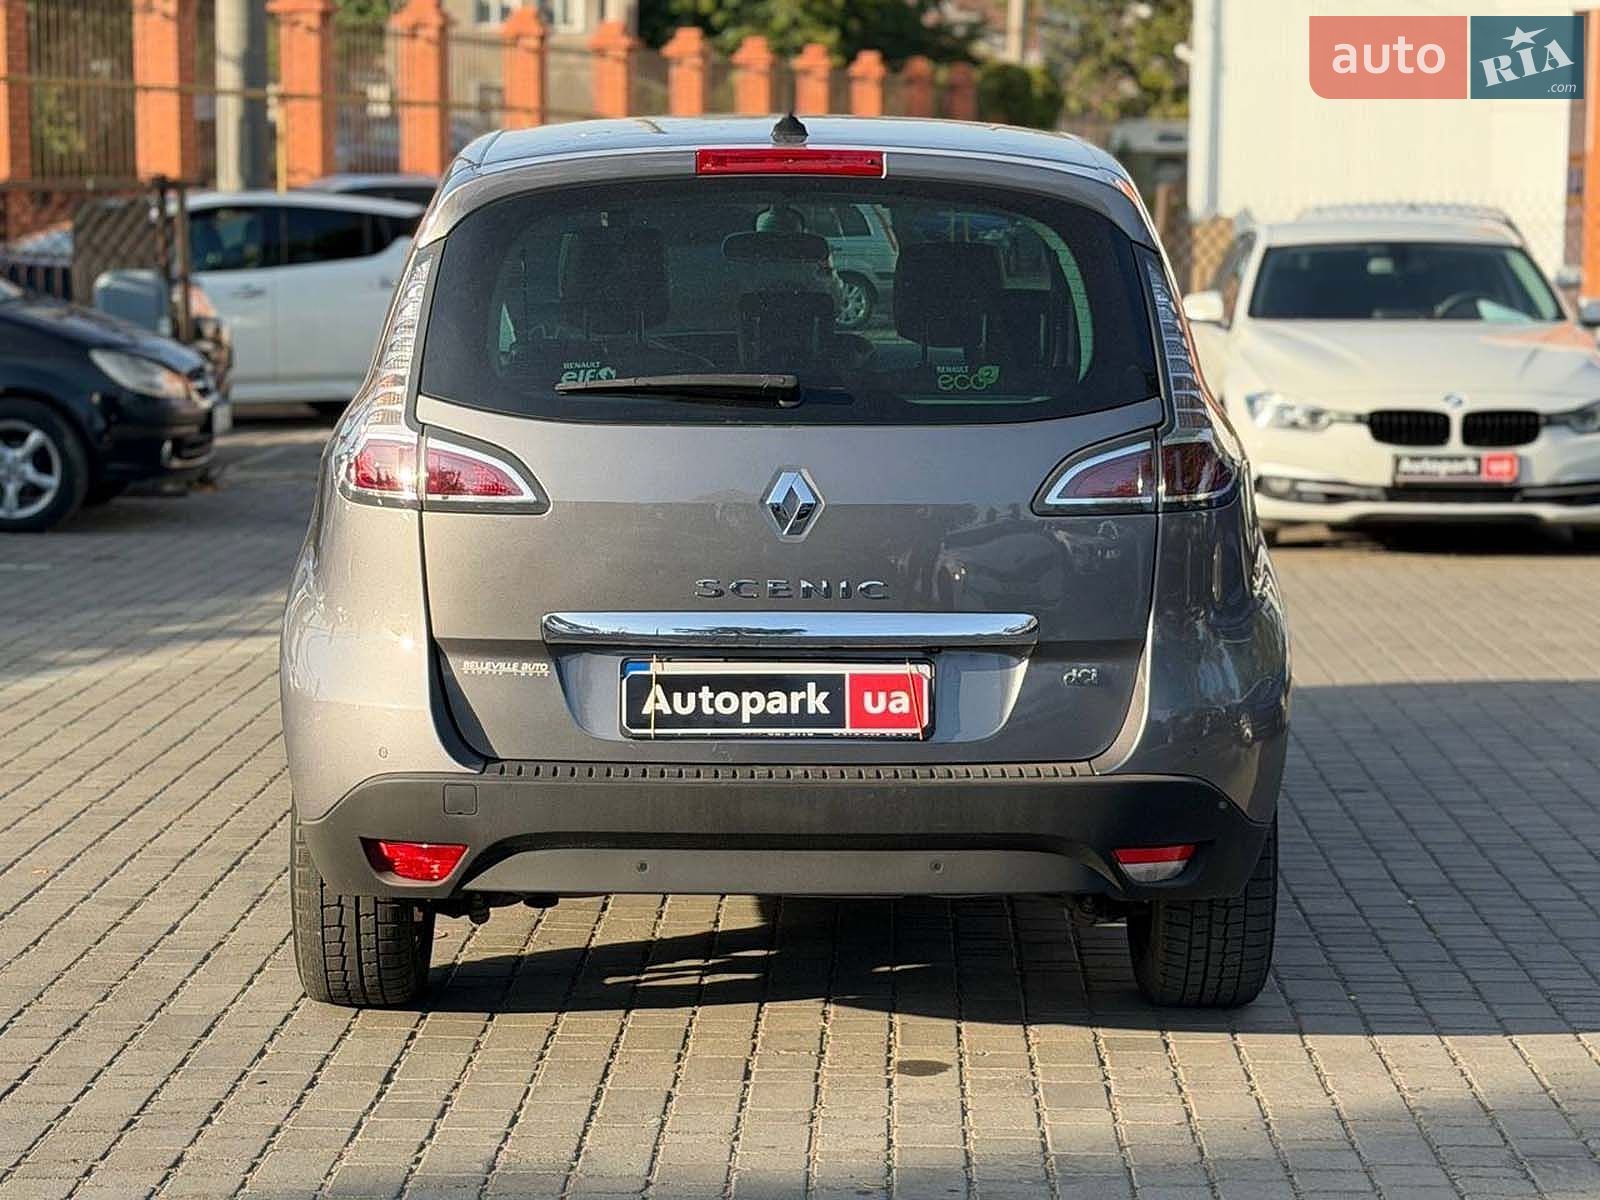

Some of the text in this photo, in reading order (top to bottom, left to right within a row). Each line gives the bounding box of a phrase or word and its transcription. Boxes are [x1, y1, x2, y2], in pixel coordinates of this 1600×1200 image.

[563, 361, 600, 369] RENAULT
[694, 578, 890, 599] SCENIC
[463, 660, 549, 672] BELLEVILLE AUTO
[641, 682, 910, 723] Autopark ua
